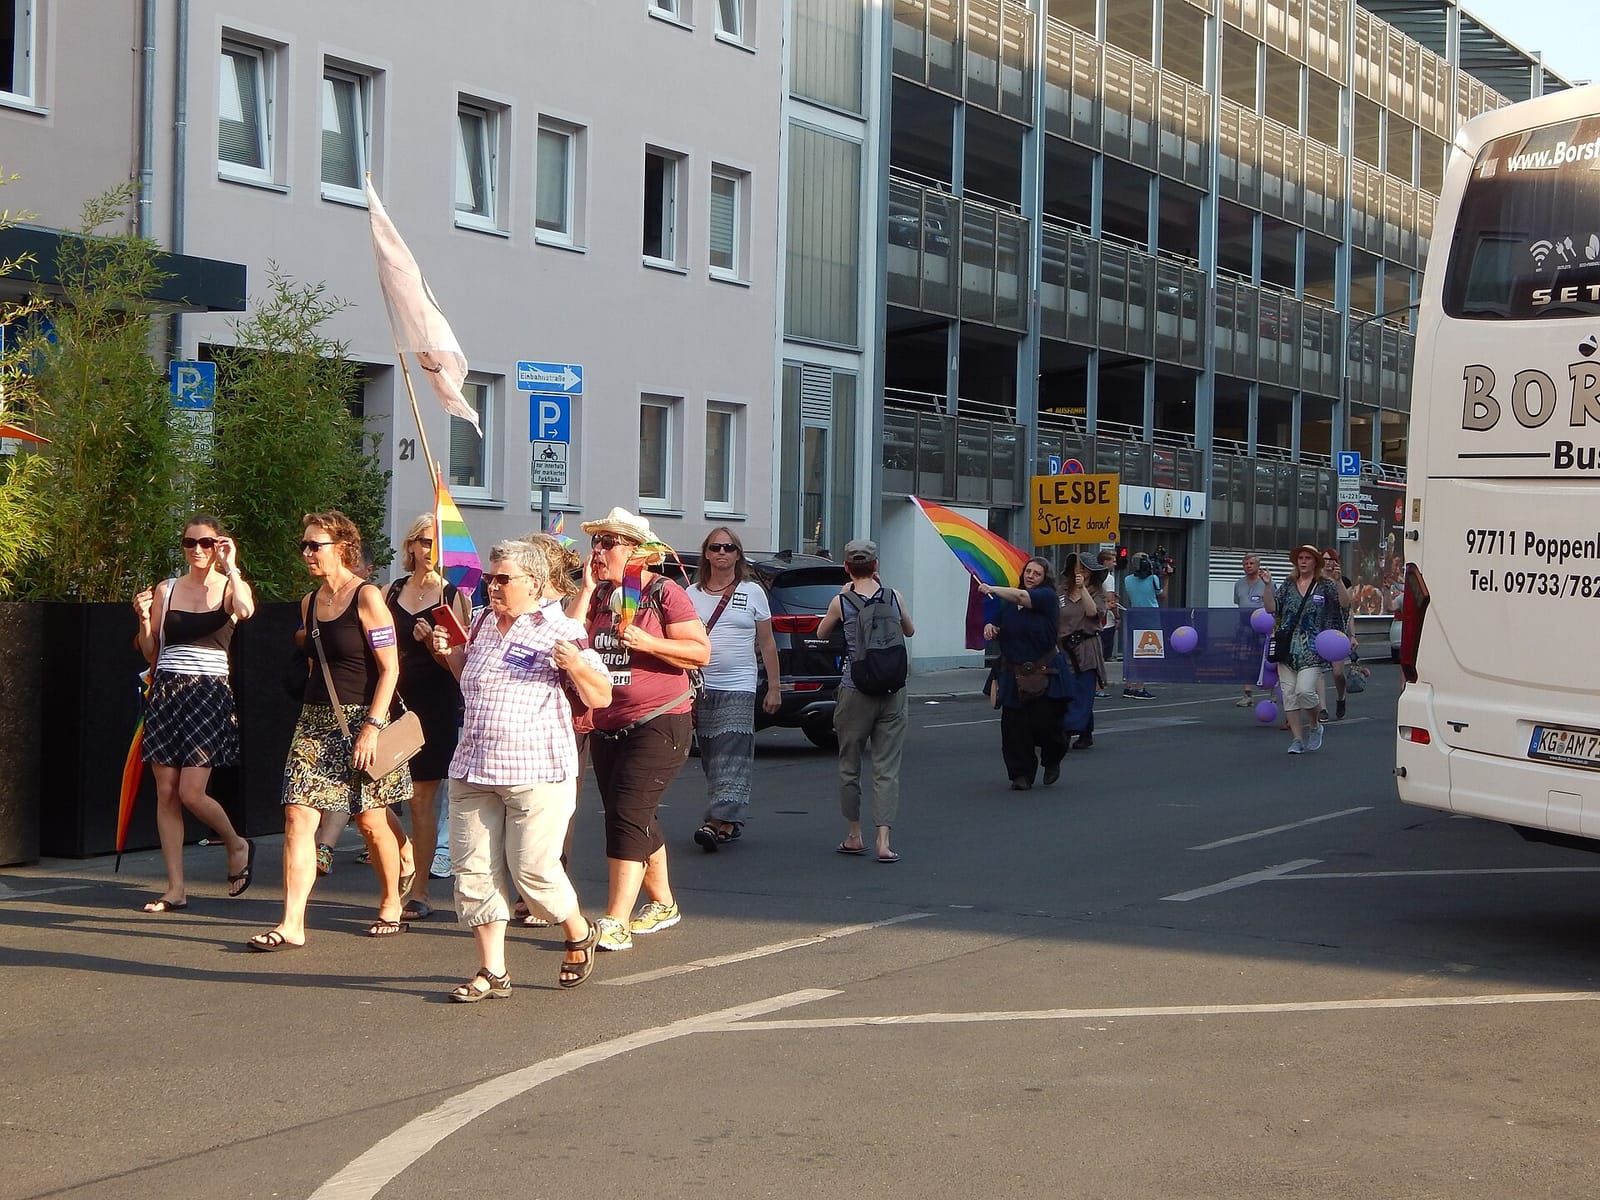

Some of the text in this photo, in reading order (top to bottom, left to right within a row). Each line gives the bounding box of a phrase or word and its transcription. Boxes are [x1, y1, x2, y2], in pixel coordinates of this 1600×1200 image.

[1532, 285, 1600, 305] SET
[177, 367, 202, 402] P
[520, 372, 566, 382] Einbahnstraße
[1461, 361, 1600, 431] BOR
[539, 401, 561, 438] P
[399, 438, 415, 460] 21
[1554, 440, 1600, 470] Bu
[1051, 460, 1058, 475] P
[1342, 454, 1354, 473] P
[1039, 480, 1111, 504] LESBE
[1038, 508, 1044, 520] &
[1086, 515, 1111, 530] darauf
[1466, 529, 1516, 556] 97711
[1470, 569, 1499, 592] Tel.
[1539, 731, 1559, 752] KG
[1565, 734, 1587, 756] AM
